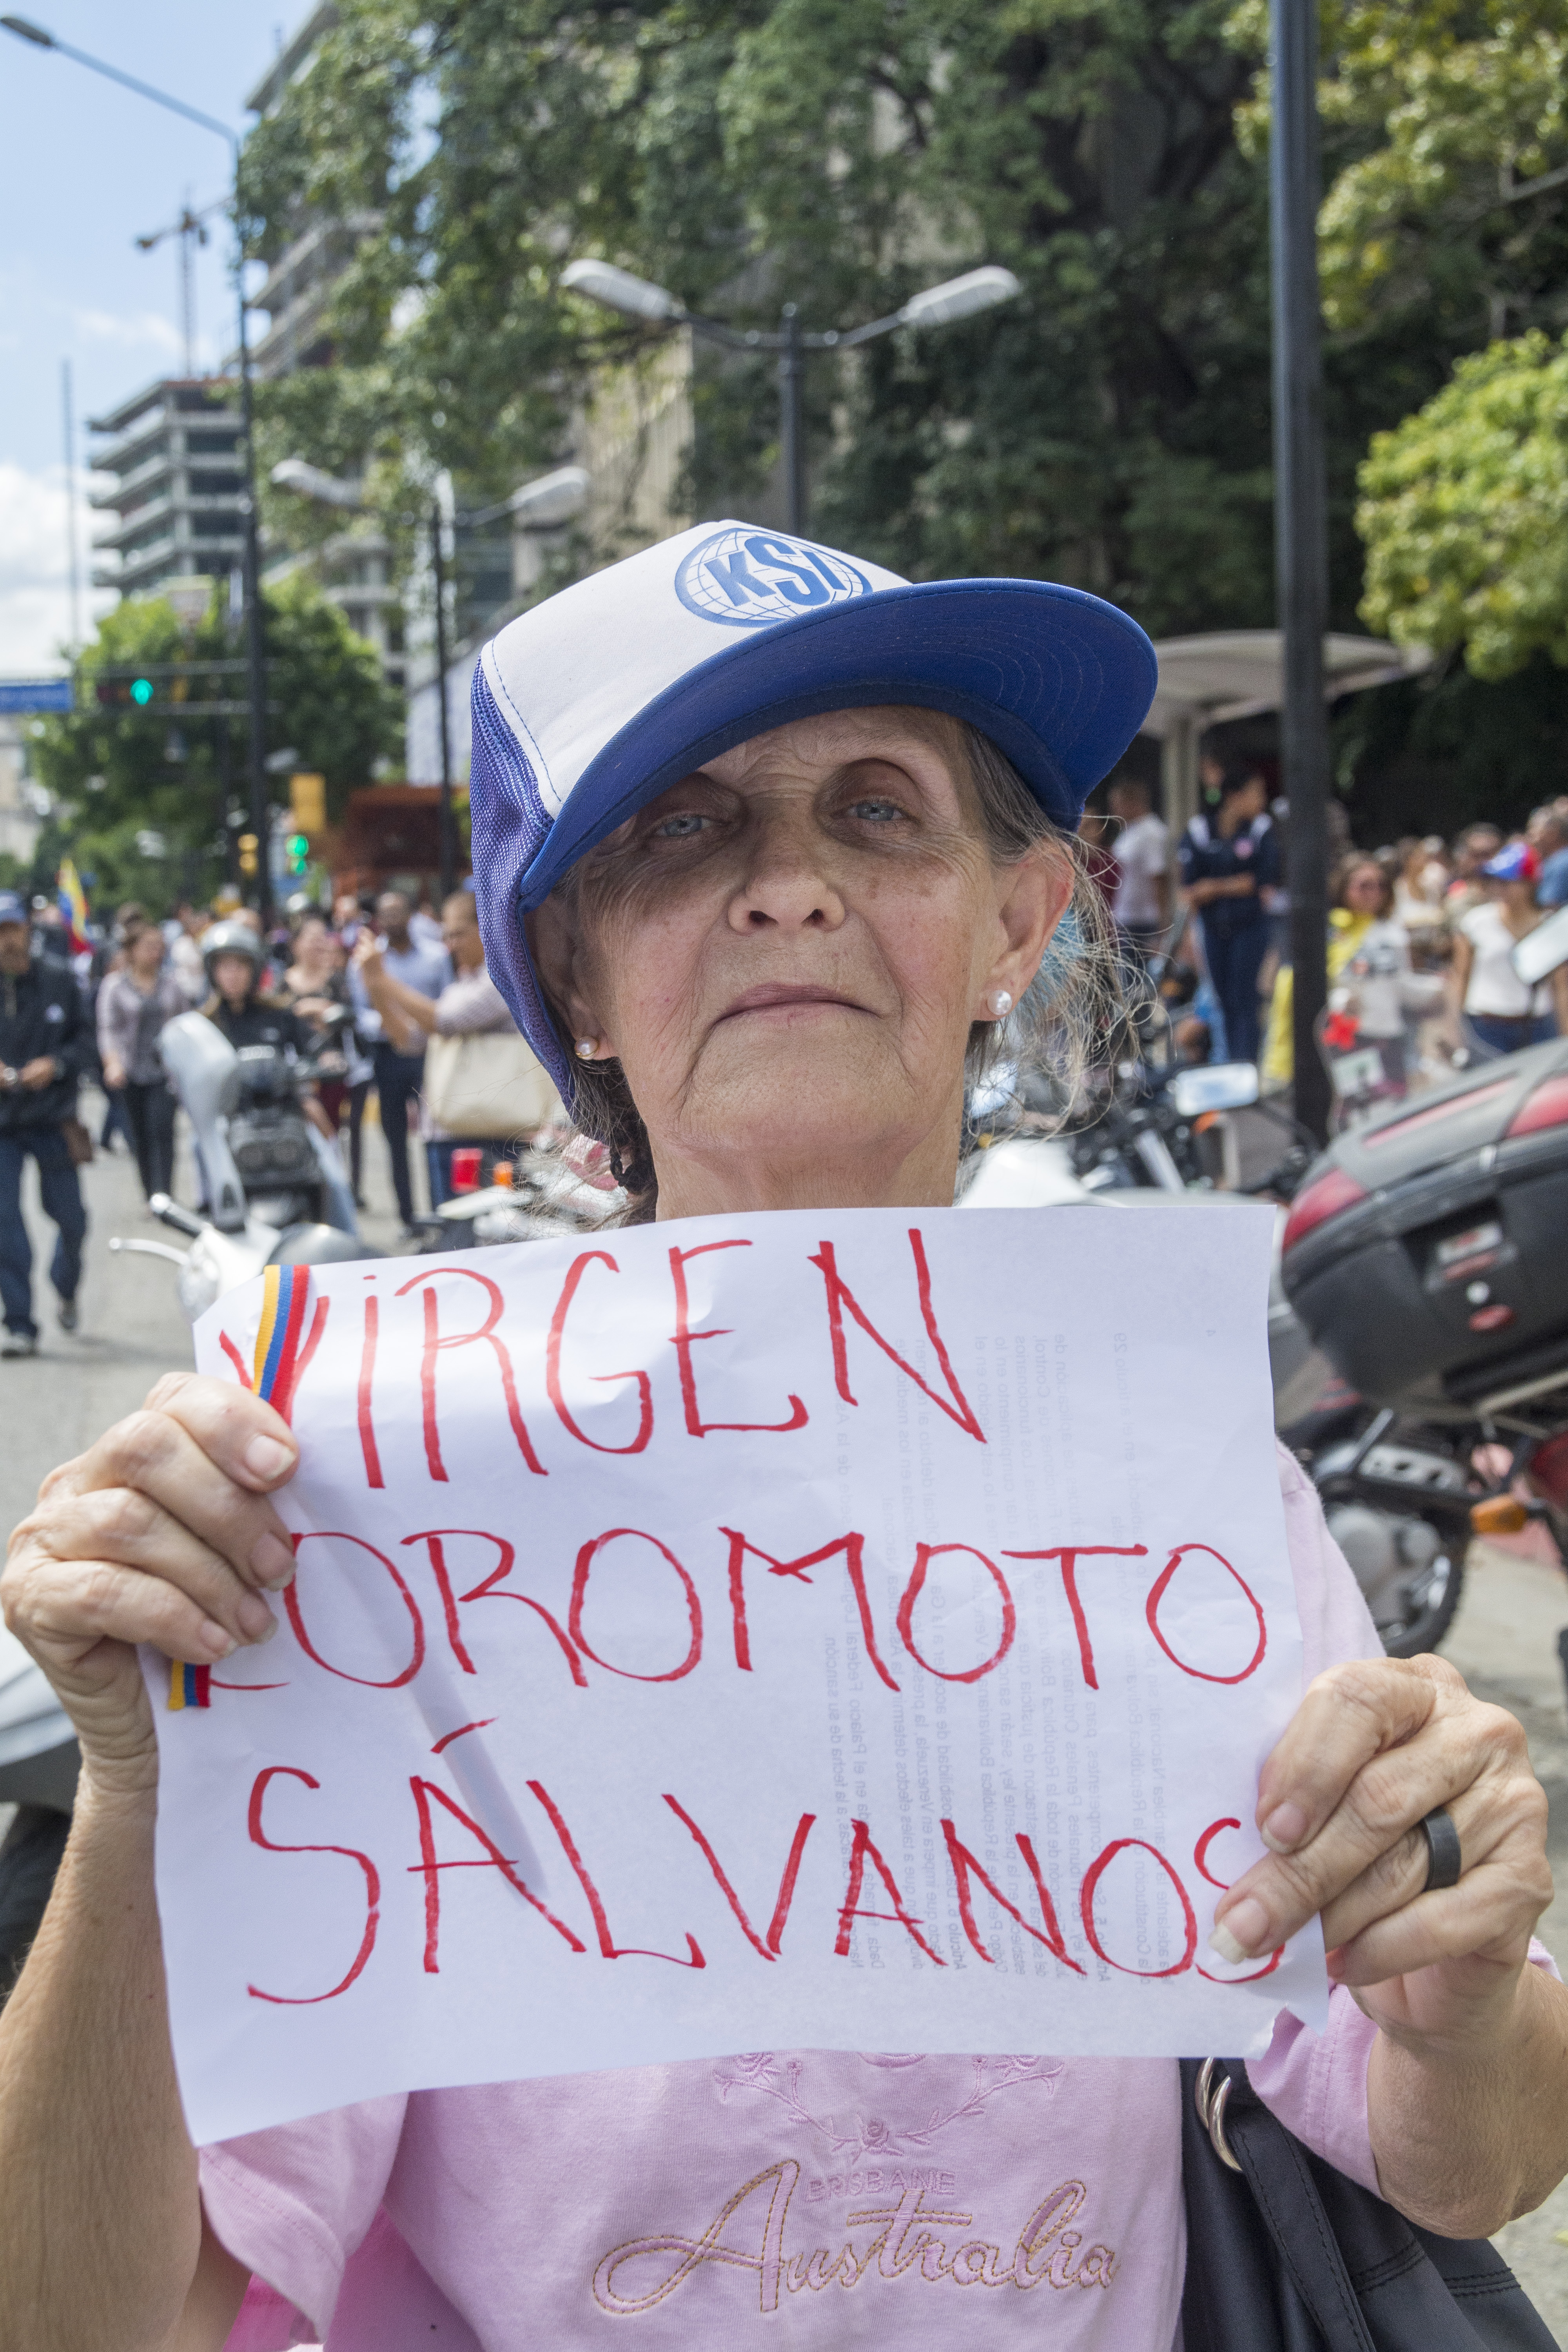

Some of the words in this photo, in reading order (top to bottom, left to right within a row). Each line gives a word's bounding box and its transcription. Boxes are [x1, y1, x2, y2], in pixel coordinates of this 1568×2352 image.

[704, 536, 847, 606] KSI
[206, 1527, 1267, 1691] OROMOTO
[592, 2159, 1116, 2313] Australia
[806, 2169, 955, 2203] BRISBANE
